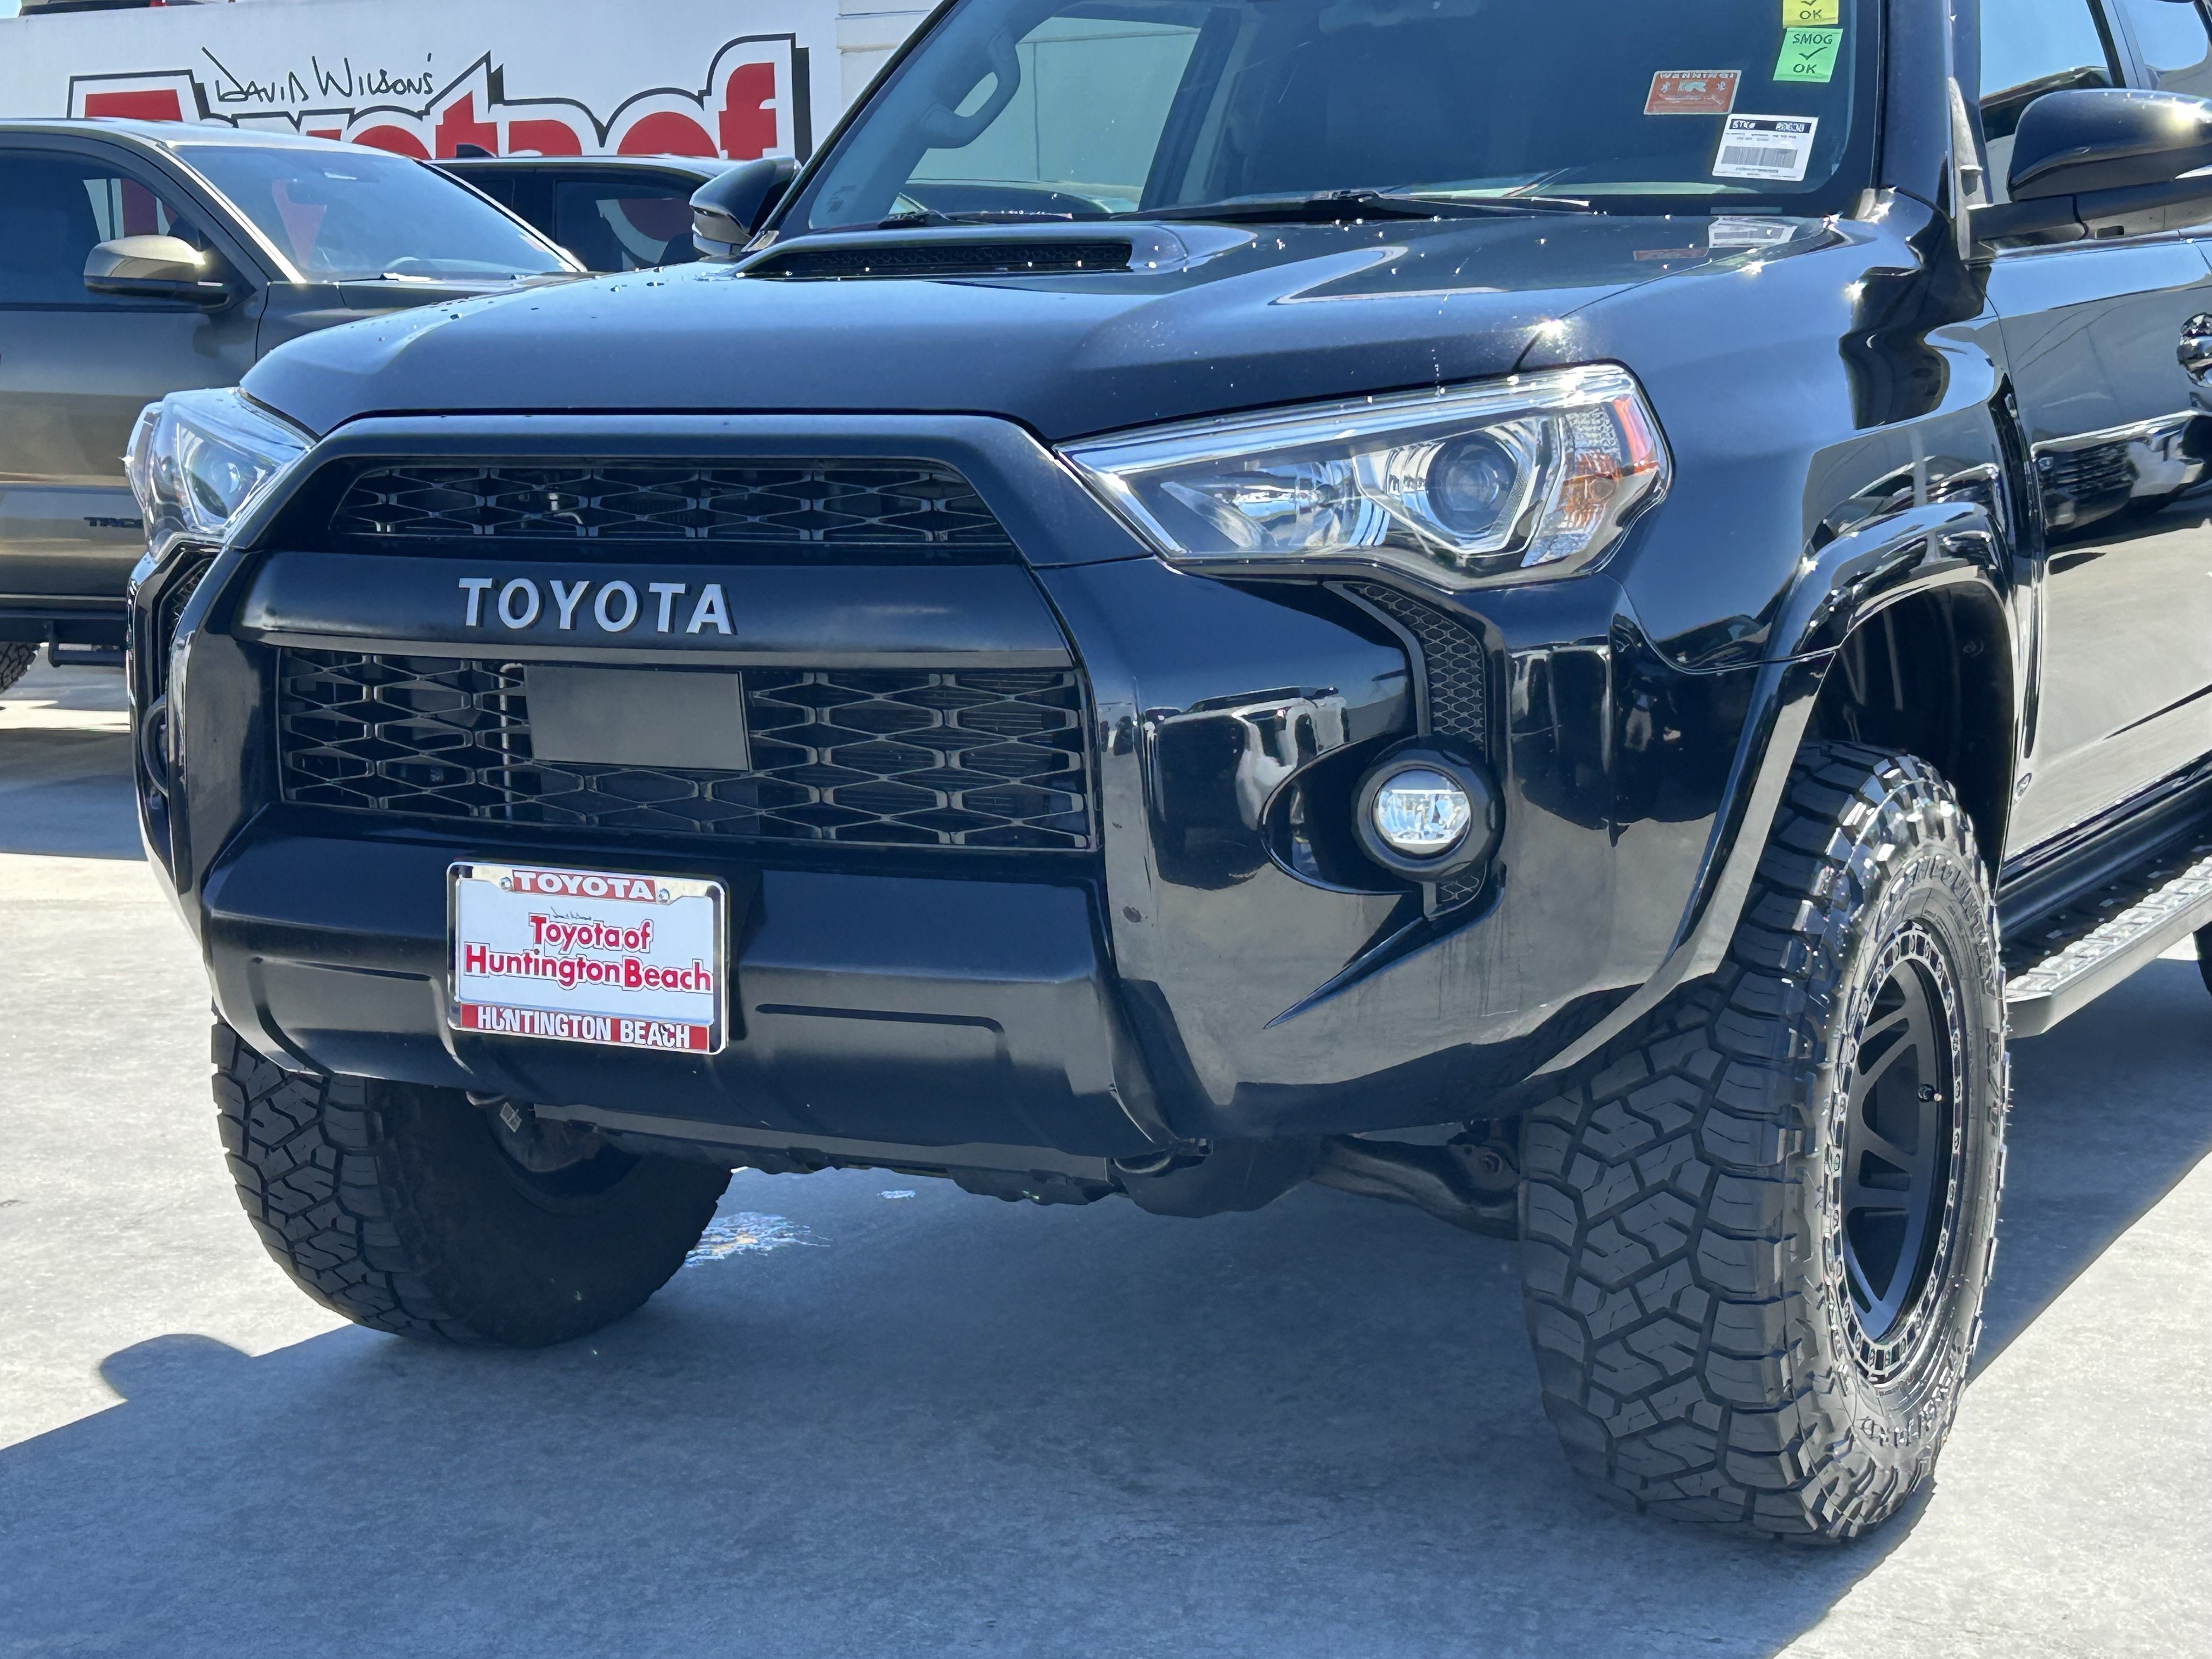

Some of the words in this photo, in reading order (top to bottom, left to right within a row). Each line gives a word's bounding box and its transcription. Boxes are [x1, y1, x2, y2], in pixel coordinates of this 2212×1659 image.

[1799, 9, 1822, 20] OK
[1792, 33, 1832, 44] SMOG
[1793, 64, 1817, 74] OK
[459, 578, 733, 635] TOYOTA
[514, 871, 654, 900] TOYOTA
[465, 944, 620, 987] Huntington
[624, 958, 711, 991] Beach
[477, 1006, 612, 1041] HUNTINGTON
[620, 1019, 690, 1049] BEACH
